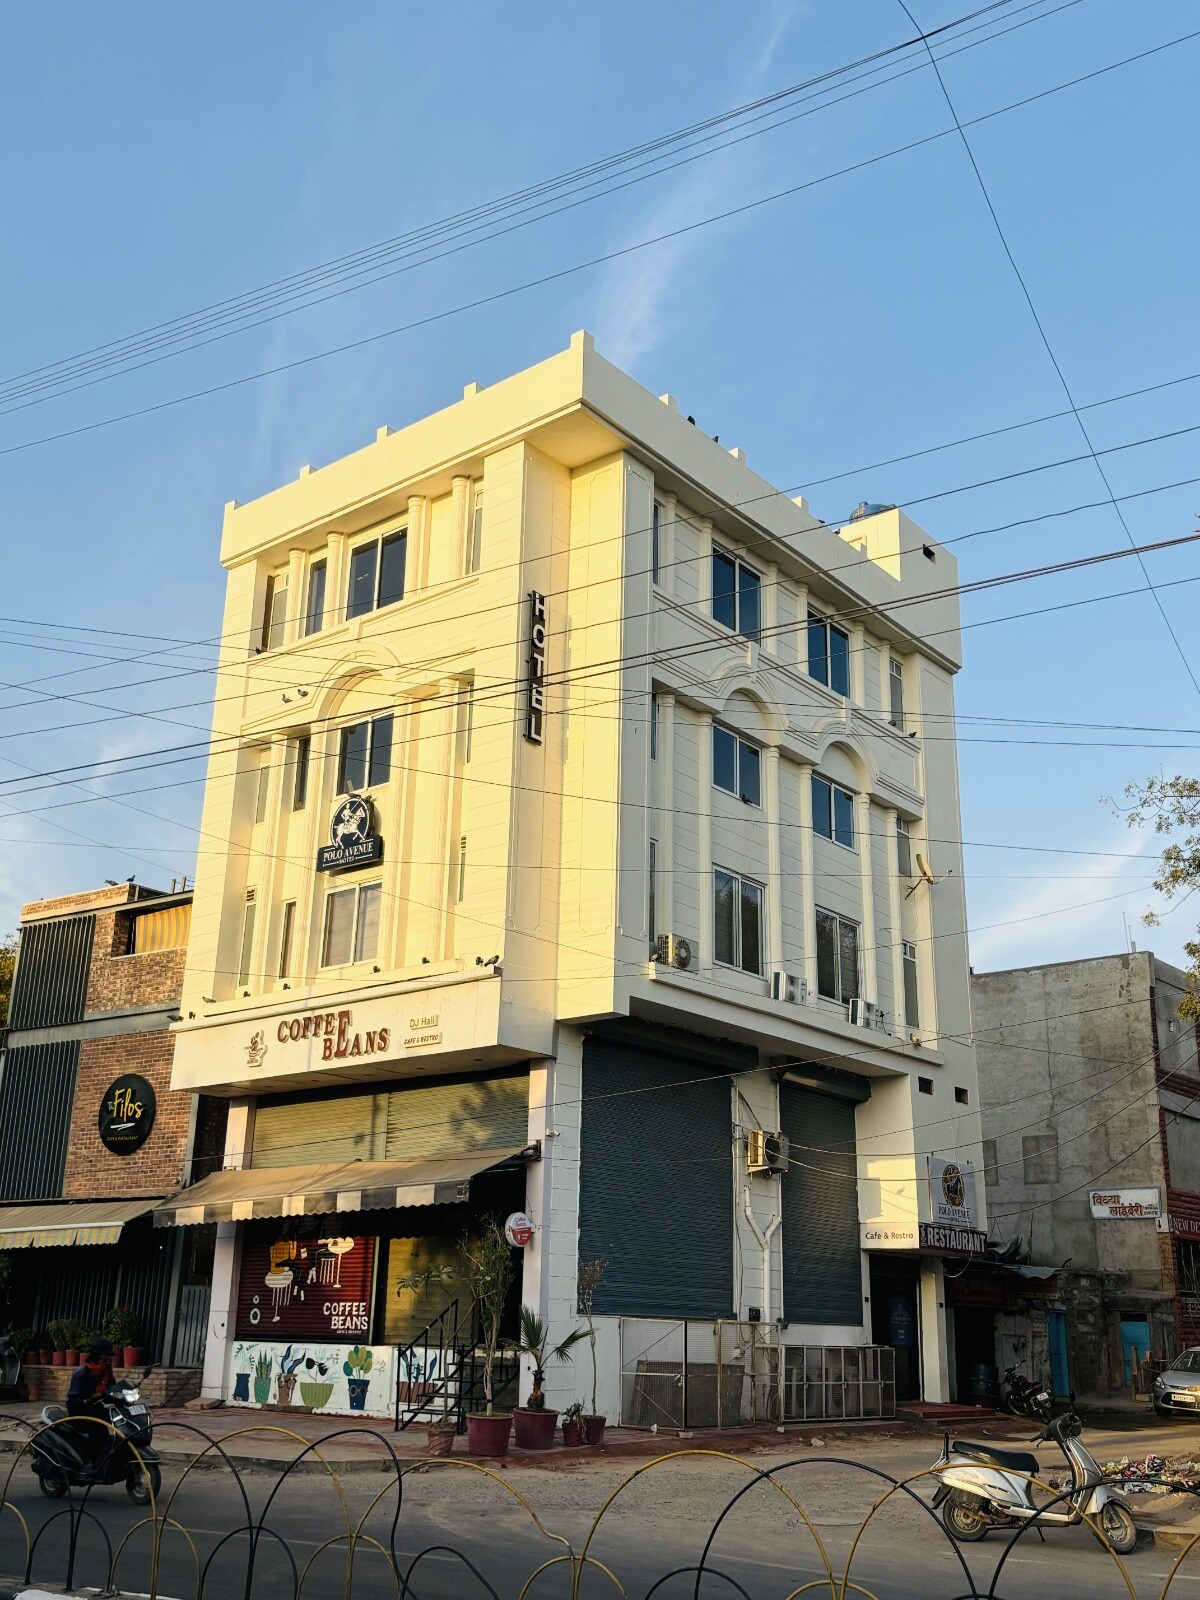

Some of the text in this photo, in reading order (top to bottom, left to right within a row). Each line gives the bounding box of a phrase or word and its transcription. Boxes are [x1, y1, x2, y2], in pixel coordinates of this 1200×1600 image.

[531, 592, 546, 742] HOTEL
[323, 842, 374, 862] POLO AVENUE
[409, 1015, 435, 1028] DJ Hall
[277, 1010, 352, 1058] COFFEE
[322, 1010, 390, 1060] BEANS
[404, 1037, 416, 1045] CAFE
[420, 1034, 439, 1043] RESTRO
[113, 1088, 144, 1123] Filos
[938, 1205, 951, 1216] POLO
[1172, 1217, 1200, 1233] NEW DE
[865, 1231, 914, 1240] Cafe & Restro
[927, 1227, 986, 1252] RESTAURANT
[323, 1302, 367, 1316] COFFEE
[331, 1316, 369, 1330] BEANS
